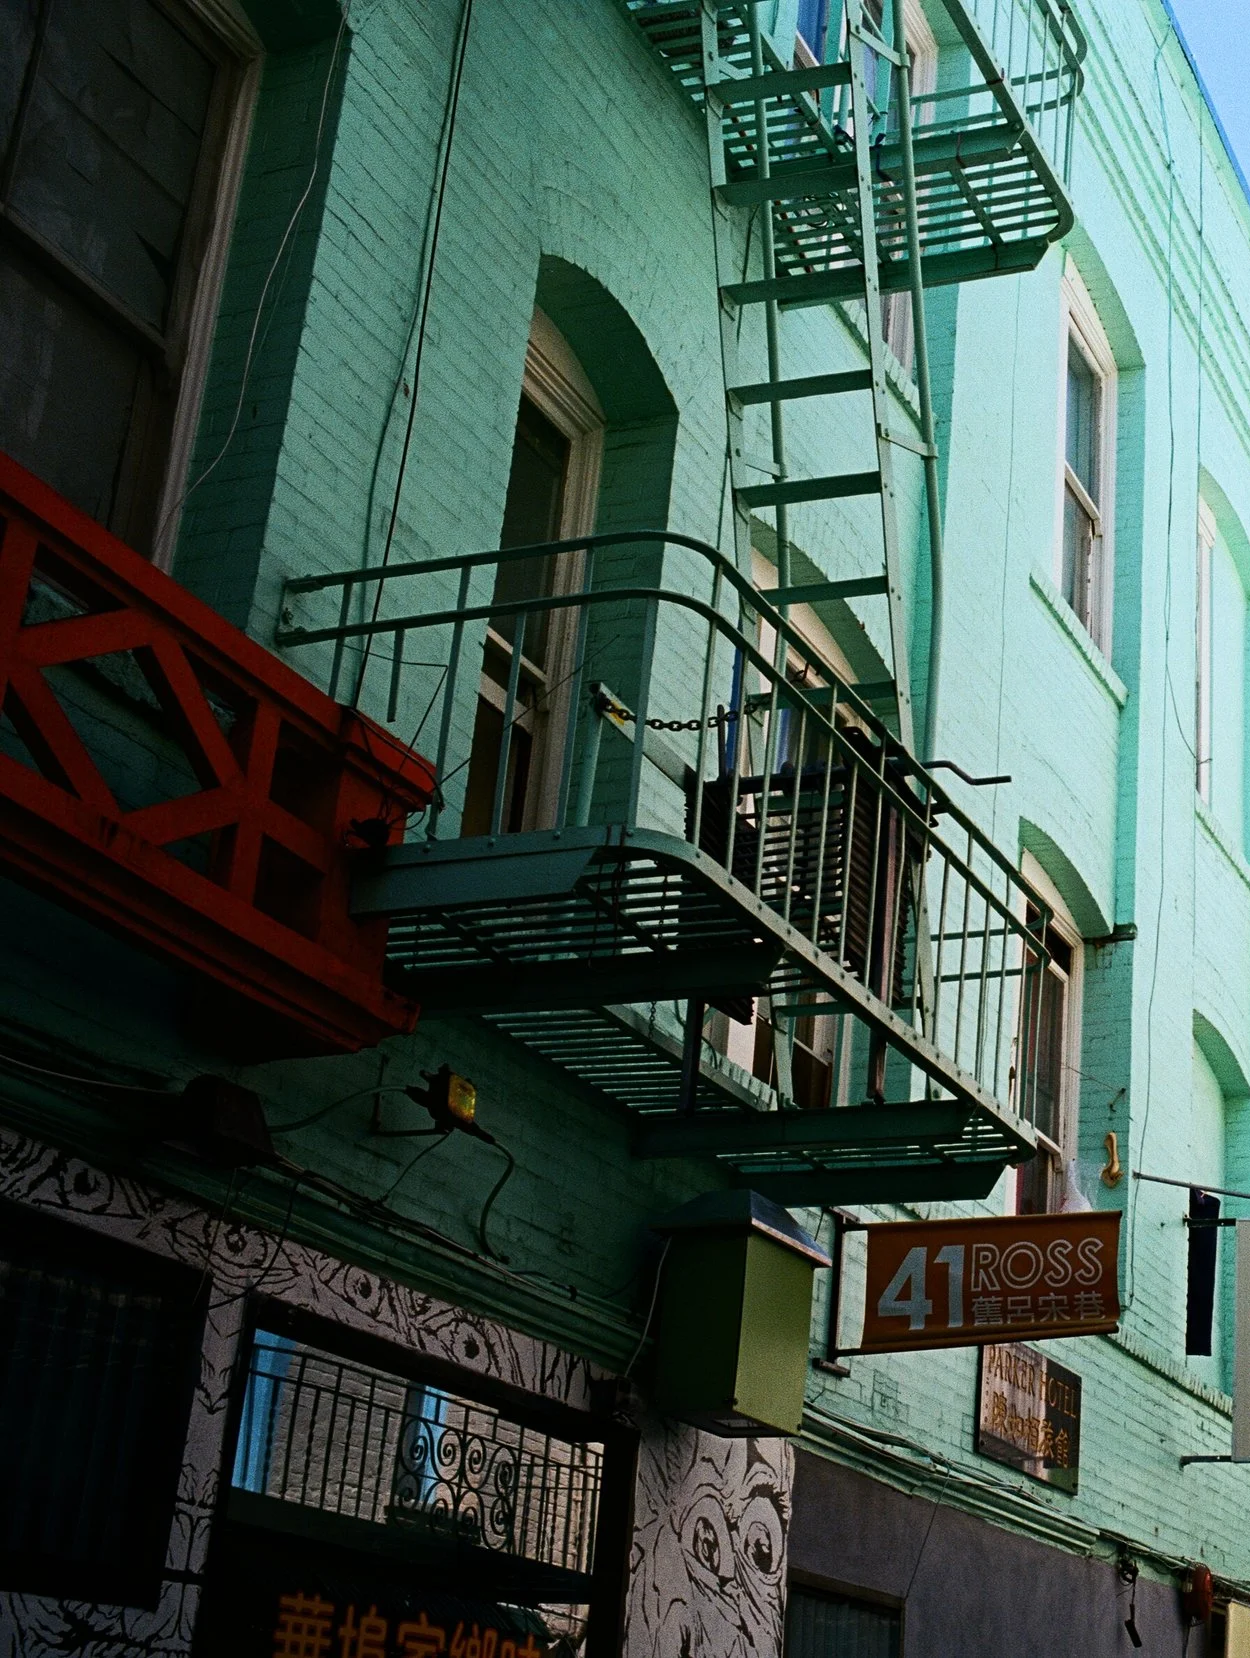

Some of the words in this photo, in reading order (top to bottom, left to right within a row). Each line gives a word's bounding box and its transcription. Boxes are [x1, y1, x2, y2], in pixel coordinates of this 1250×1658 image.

[878, 1244, 965, 1330] 41
[971, 1237, 1104, 1292] ROSS
[988, 1344, 1036, 1397] PARKER
[1039, 1370, 1077, 1418] HOTEL
